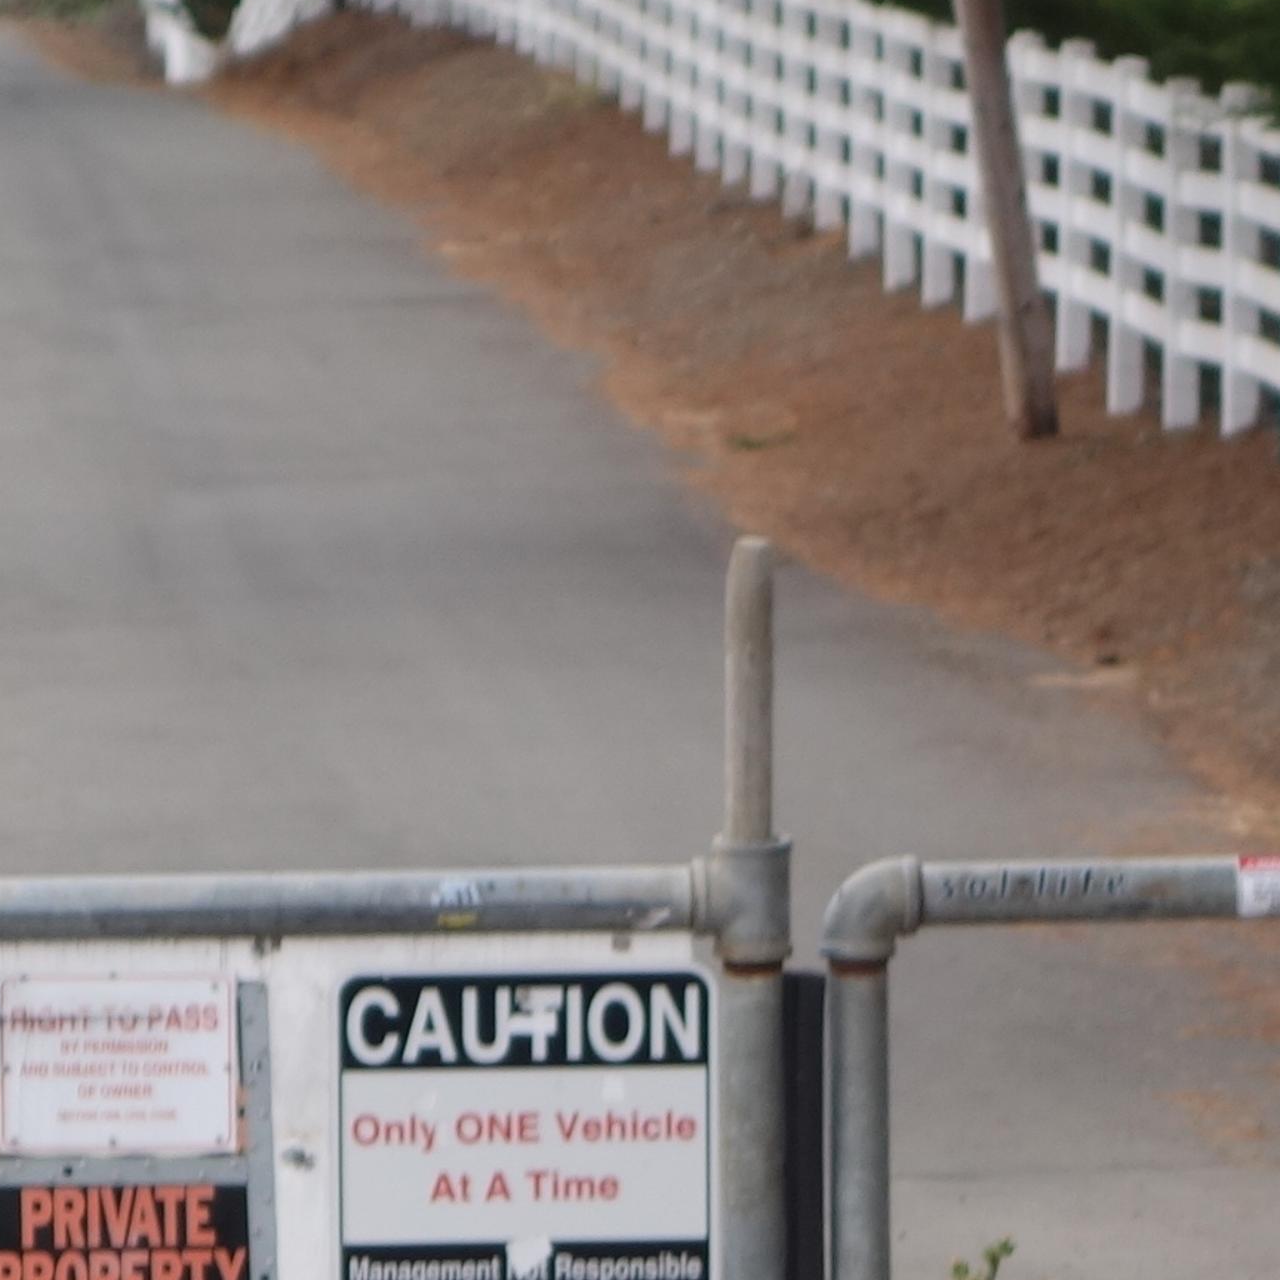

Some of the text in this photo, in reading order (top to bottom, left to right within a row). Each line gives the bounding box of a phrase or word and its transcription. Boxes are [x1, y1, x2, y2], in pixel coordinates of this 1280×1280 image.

[147, 1001, 219, 1032] PASS
[345, 982, 701, 1065] CAUTION
[351, 1109, 697, 1153] Only ONE Vehicle
[430, 1169, 620, 1204] At A Time
[20, 1183, 216, 1250] PRIVATE
